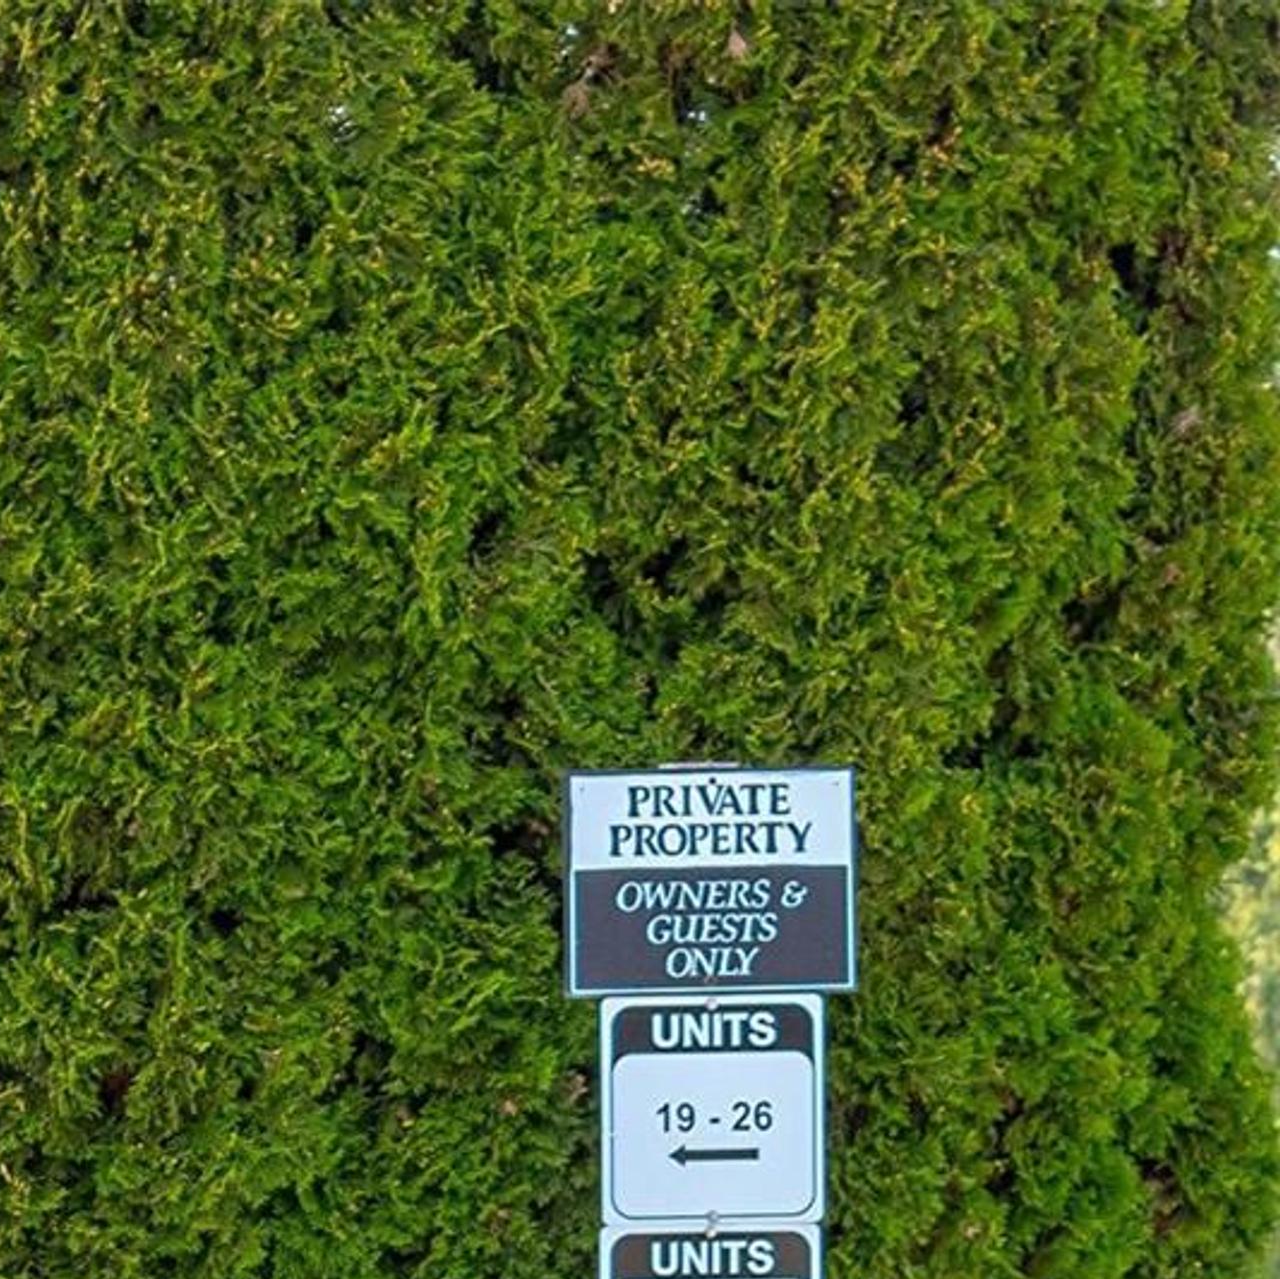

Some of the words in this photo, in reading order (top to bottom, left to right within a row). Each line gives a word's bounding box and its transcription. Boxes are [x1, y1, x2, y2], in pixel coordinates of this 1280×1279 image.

[627, 783, 790, 817] PRIVATE
[608, 821, 813, 857] PROPERTY
[615, 878, 772, 913] OWNERS
[780, 880, 807, 908] &
[645, 911, 778, 945] GUESTS
[665, 946, 760, 978] ONLY
[650, 1012, 777, 1049] UNITS
[656, 1102, 696, 1133] 19
[731, 1101, 774, 1132] 26
[650, 1240, 776, 1276] UNITS
